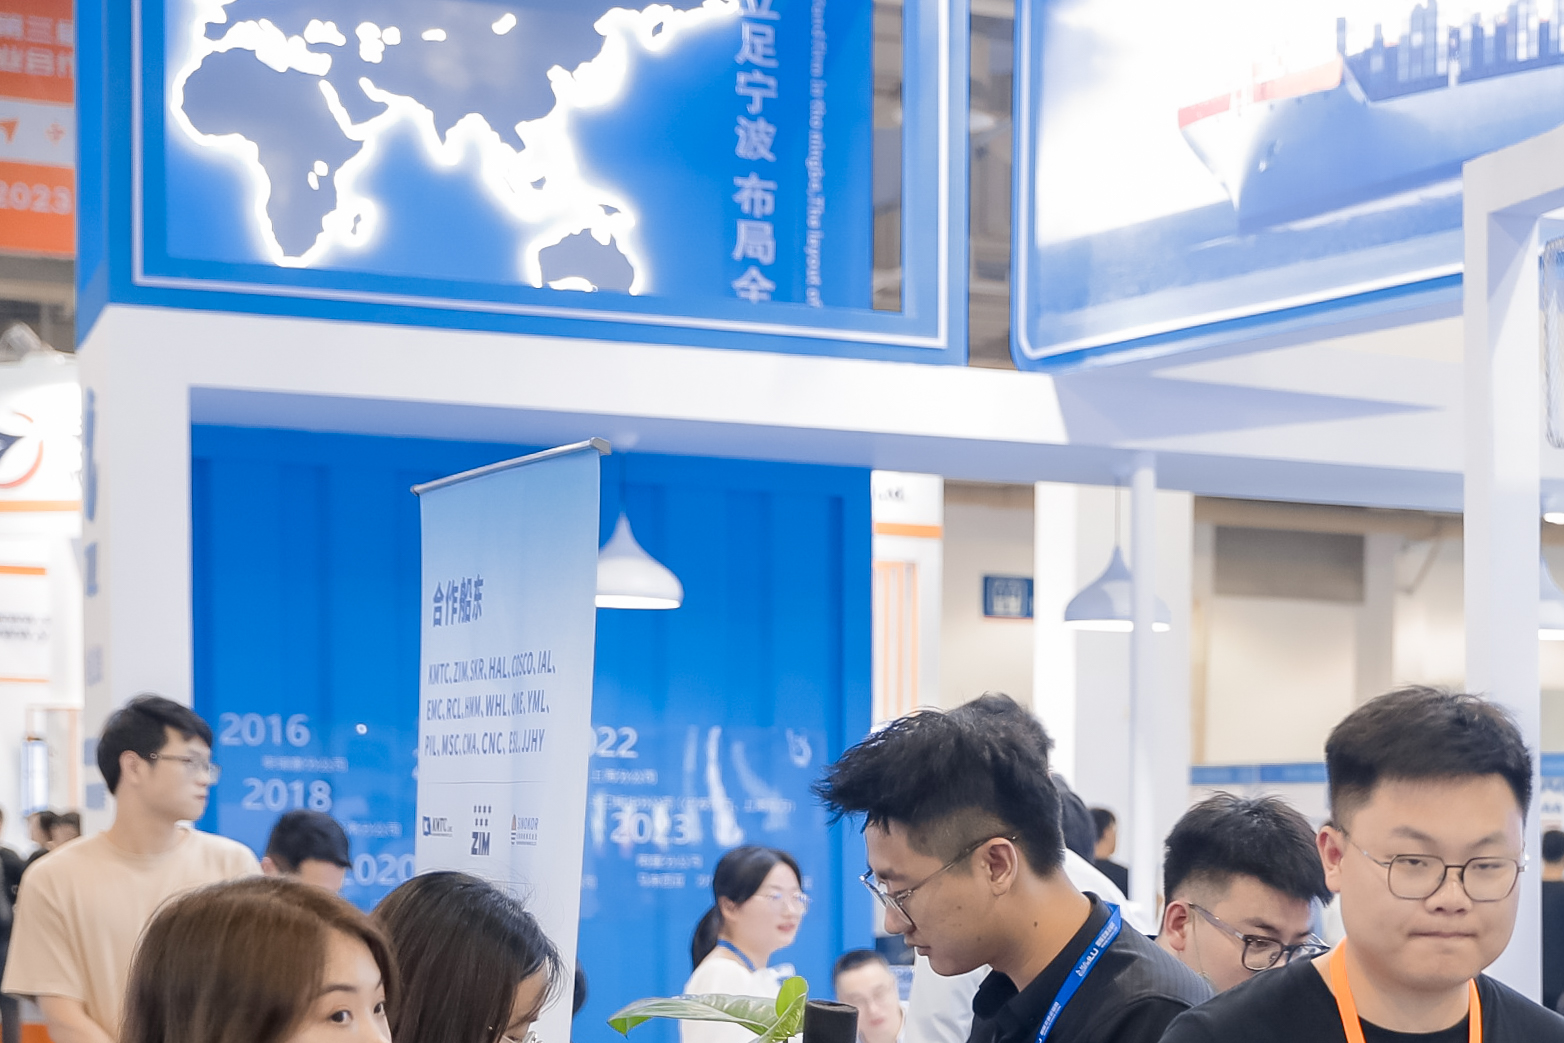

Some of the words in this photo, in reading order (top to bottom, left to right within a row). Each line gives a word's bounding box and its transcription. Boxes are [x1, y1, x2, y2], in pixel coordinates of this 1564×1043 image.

[432, 574, 484, 627] 合作船东
[218, 712, 311, 747] 2016
[242, 777, 333, 813] 2018
[471, 831, 491, 856] ZIM
[344, 853, 416, 887] 020
